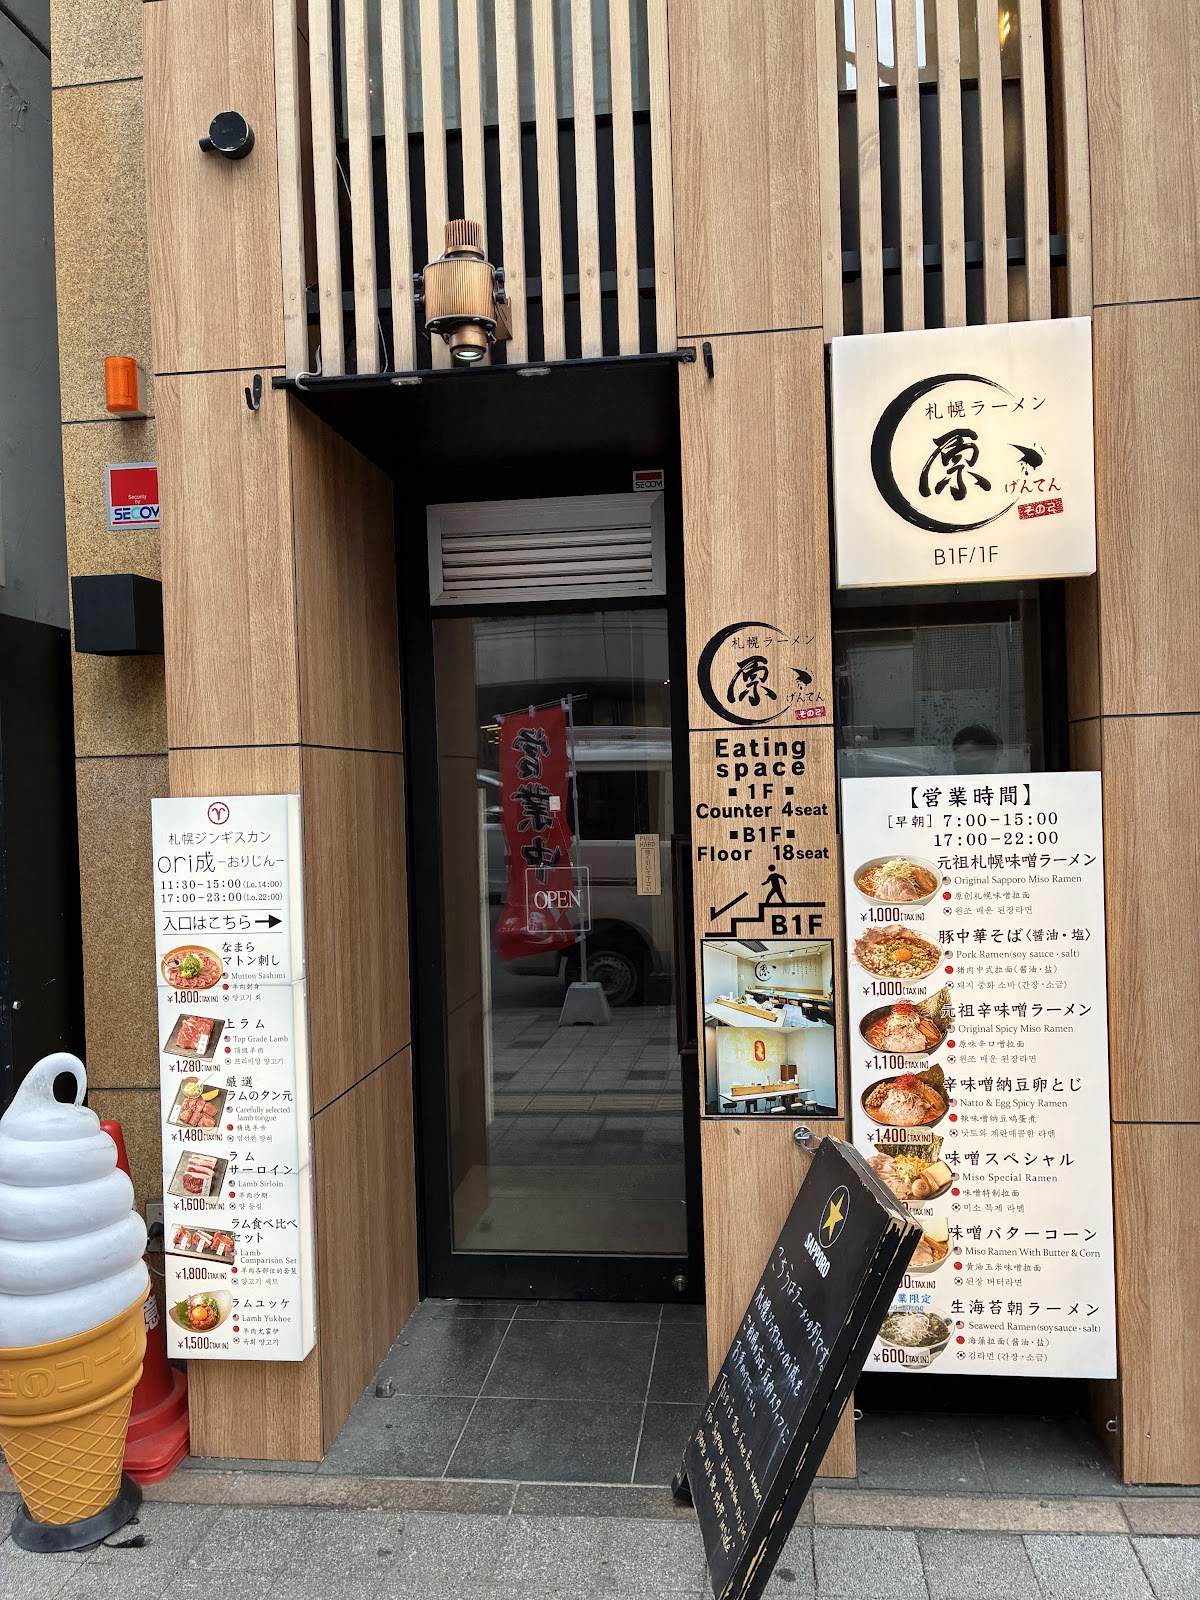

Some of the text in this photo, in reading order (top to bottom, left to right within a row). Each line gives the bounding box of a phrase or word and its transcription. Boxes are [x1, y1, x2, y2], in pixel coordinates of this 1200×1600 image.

[925, 397, 1046, 420] 札幌ラーメン
[919, 428, 991, 501] 原
[1004, 477, 1062, 494] げんてん
[934, 546, 999, 565] B1F/1F
[732, 635, 815, 649] 札幌ラーメン
[727, 656, 777, 706] 原
[786, 692, 824, 702] げんてん
[716, 737, 805, 759] Eating
[717, 761, 805, 781] space
[911, 784, 1030, 808] 【営業時間】
[696, 803, 772, 819] Counter
[169, 831, 271, 845] 札幌ジンギスカン
[698, 846, 752, 861] Floor
[937, 853, 1096, 870] 元祖札幌味噌ラーメン
[955, 874, 1081, 887] Original Sapporo Miso Ramen
[534, 890, 581, 909] OPEN
[163, 915, 251, 931] 入口はこちら
[772, 915, 822, 935] B1F
[222, 942, 255, 952] なまら
[223, 955, 280, 966] マトン刺し
[956, 950, 976, 959] Pork
[942, 1003, 1092, 1018] 元祖辛味噌ラーメン
[958, 1024, 1073, 1035] Original Spicy Miso Ramen
[233, 1036, 244, 1044] Top
[226, 1076, 253, 1087] 厳選
[944, 1076, 1082, 1093] 辛味噌納豆卵とじ
[228, 1090, 293, 1102] ラムのタン元
[236, 1106, 264, 1114] Carefully
[960, 1099, 983, 1108] Natto
[995, 1099, 1011, 1110] Egg
[1013, 1099, 1035, 1110] Spicy
[1038, 1100, 1067, 1108] Ramen
[229, 1151, 255, 1162] ラム
[945, 1151, 1075, 1167] 味噌スペシャル
[229, 1165, 293, 1176] サーロイン
[962, 1173, 1058, 1183] Miso Special Ramen
[232, 1218, 298, 1230] ラム食べ比べ
[232, 1232, 264, 1244] セット
[948, 1225, 1097, 1242] 味噌バターコーン
[805, 1232, 831, 1279] SAPPORO
[966, 1247, 986, 1256] Miso
[988, 1248, 1017, 1256] Ramen
[1020, 1248, 1041, 1256] With
[1043, 1248, 1069, 1257] Butter
[1072, 1249, 1078, 1257] &
[240, 1257, 284, 1265] Comparison
[233, 1298, 290, 1309] ラムユッケ
[951, 1299, 1100, 1316] 生海苔朝ラーメン
[969, 1321, 1004, 1331] Seaweed
[717, 1373, 730, 1406] This
[726, 1398, 735, 1418] is
